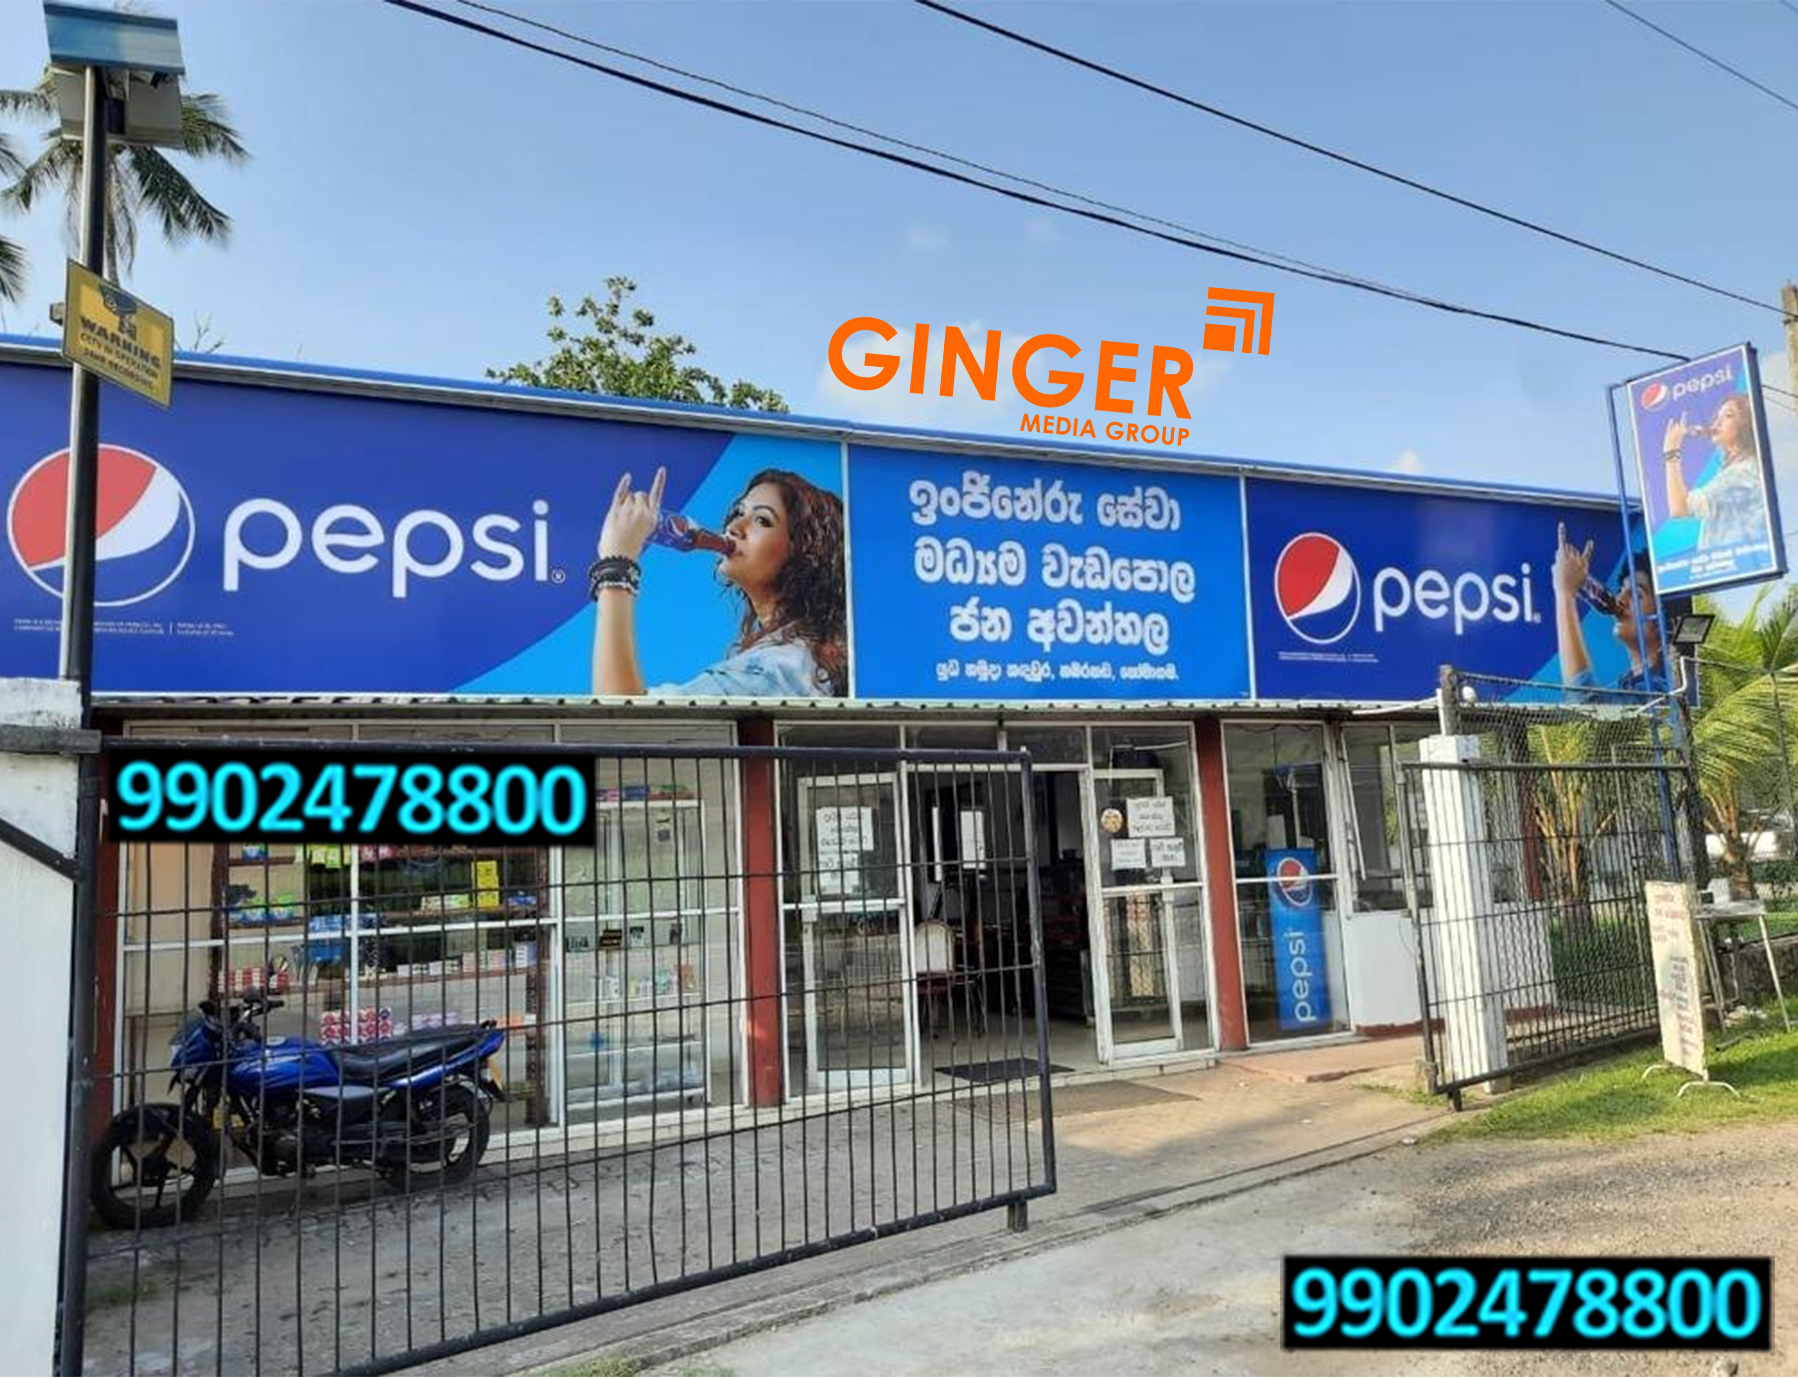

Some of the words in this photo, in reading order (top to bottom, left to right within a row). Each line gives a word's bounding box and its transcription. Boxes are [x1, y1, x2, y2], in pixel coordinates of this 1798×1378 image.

[80, 315, 160, 369] WARNING
[1672, 364, 1733, 402] pepsi
[1097, 485, 1182, 531] සේවා
[223, 498, 549, 598] pepsi
[950, 596, 1012, 641] ජන
[1373, 563, 1531, 635] pepsi
[1283, 931, 1318, 1023] pepsi
